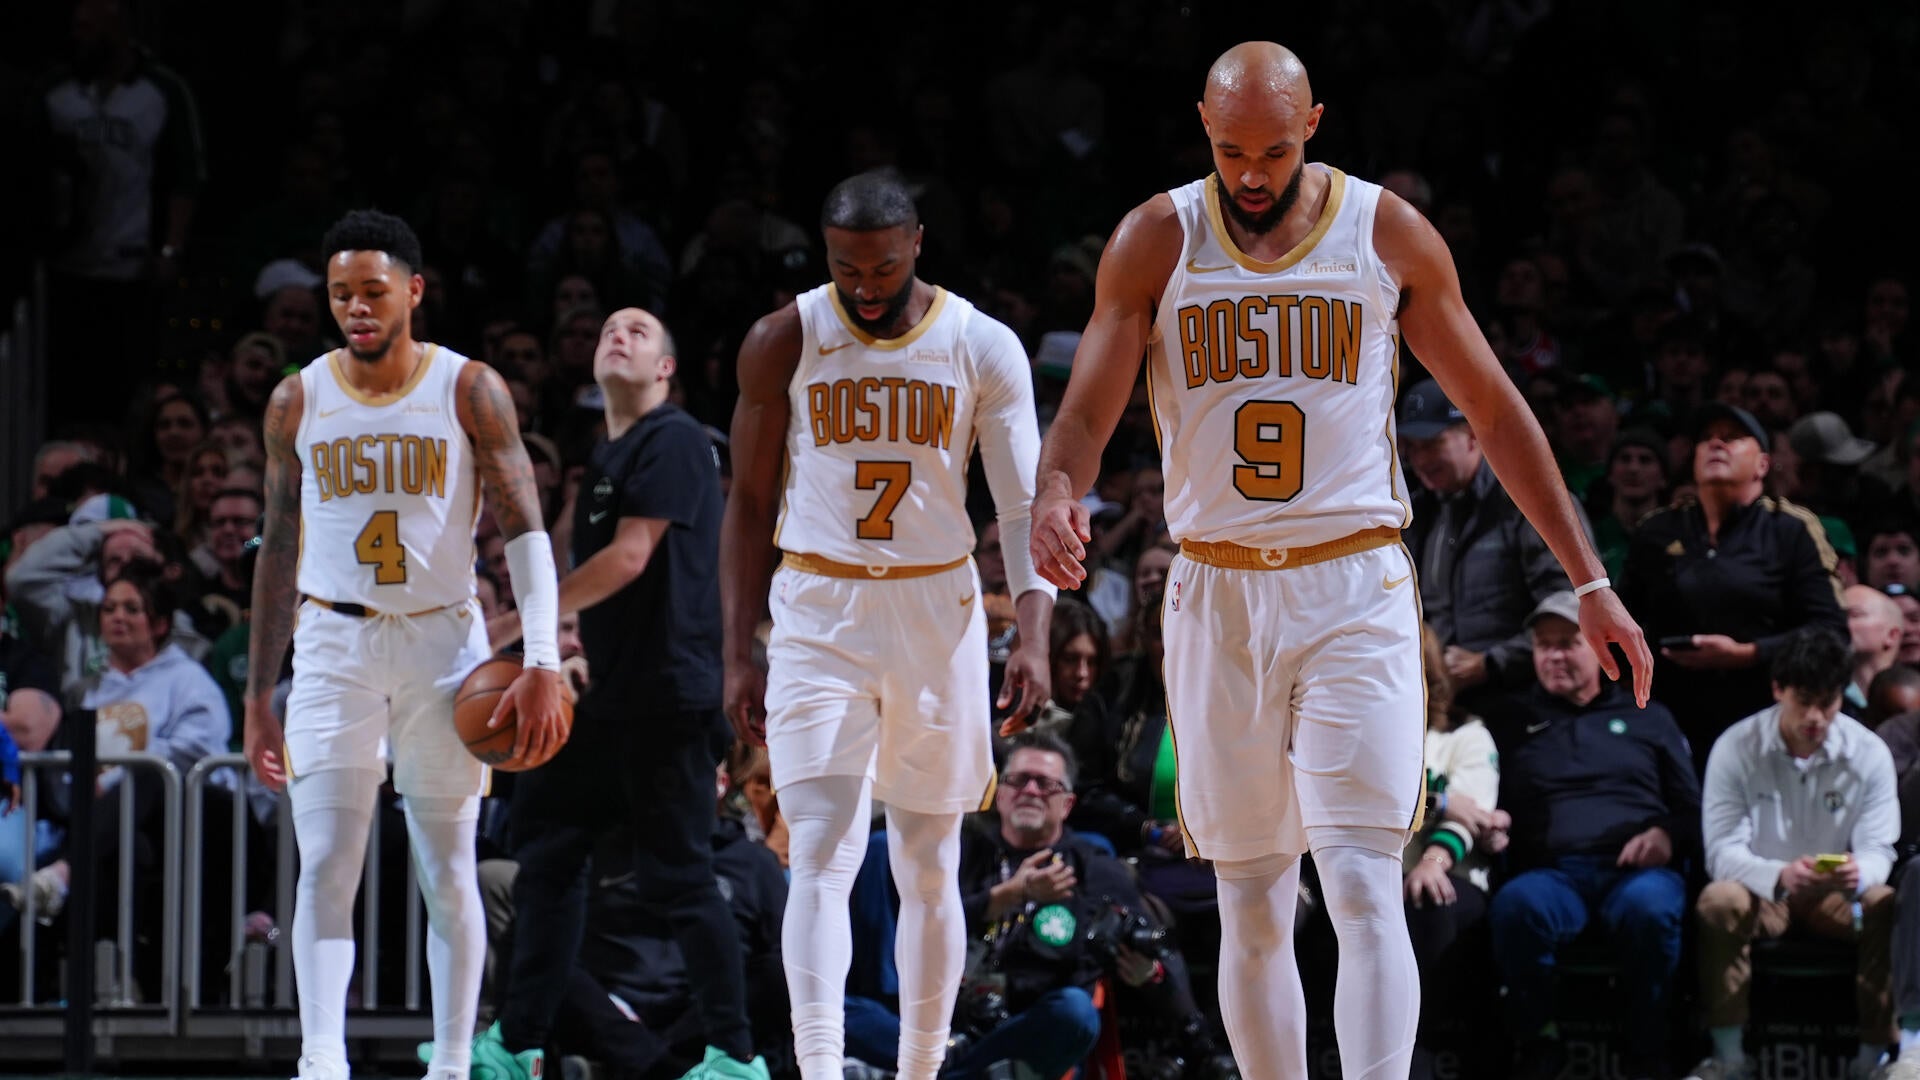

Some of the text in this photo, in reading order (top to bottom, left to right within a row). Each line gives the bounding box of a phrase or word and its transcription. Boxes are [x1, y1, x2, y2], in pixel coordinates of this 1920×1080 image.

[1304, 261, 1356, 275] Amica
[1178, 295, 1362, 390] BOSTON
[808, 376, 956, 450] BOSTON
[1233, 399, 1306, 502] 9
[310, 433, 447, 504] BOSTON
[855, 460, 912, 540] 7
[353, 510, 406, 586] 4
